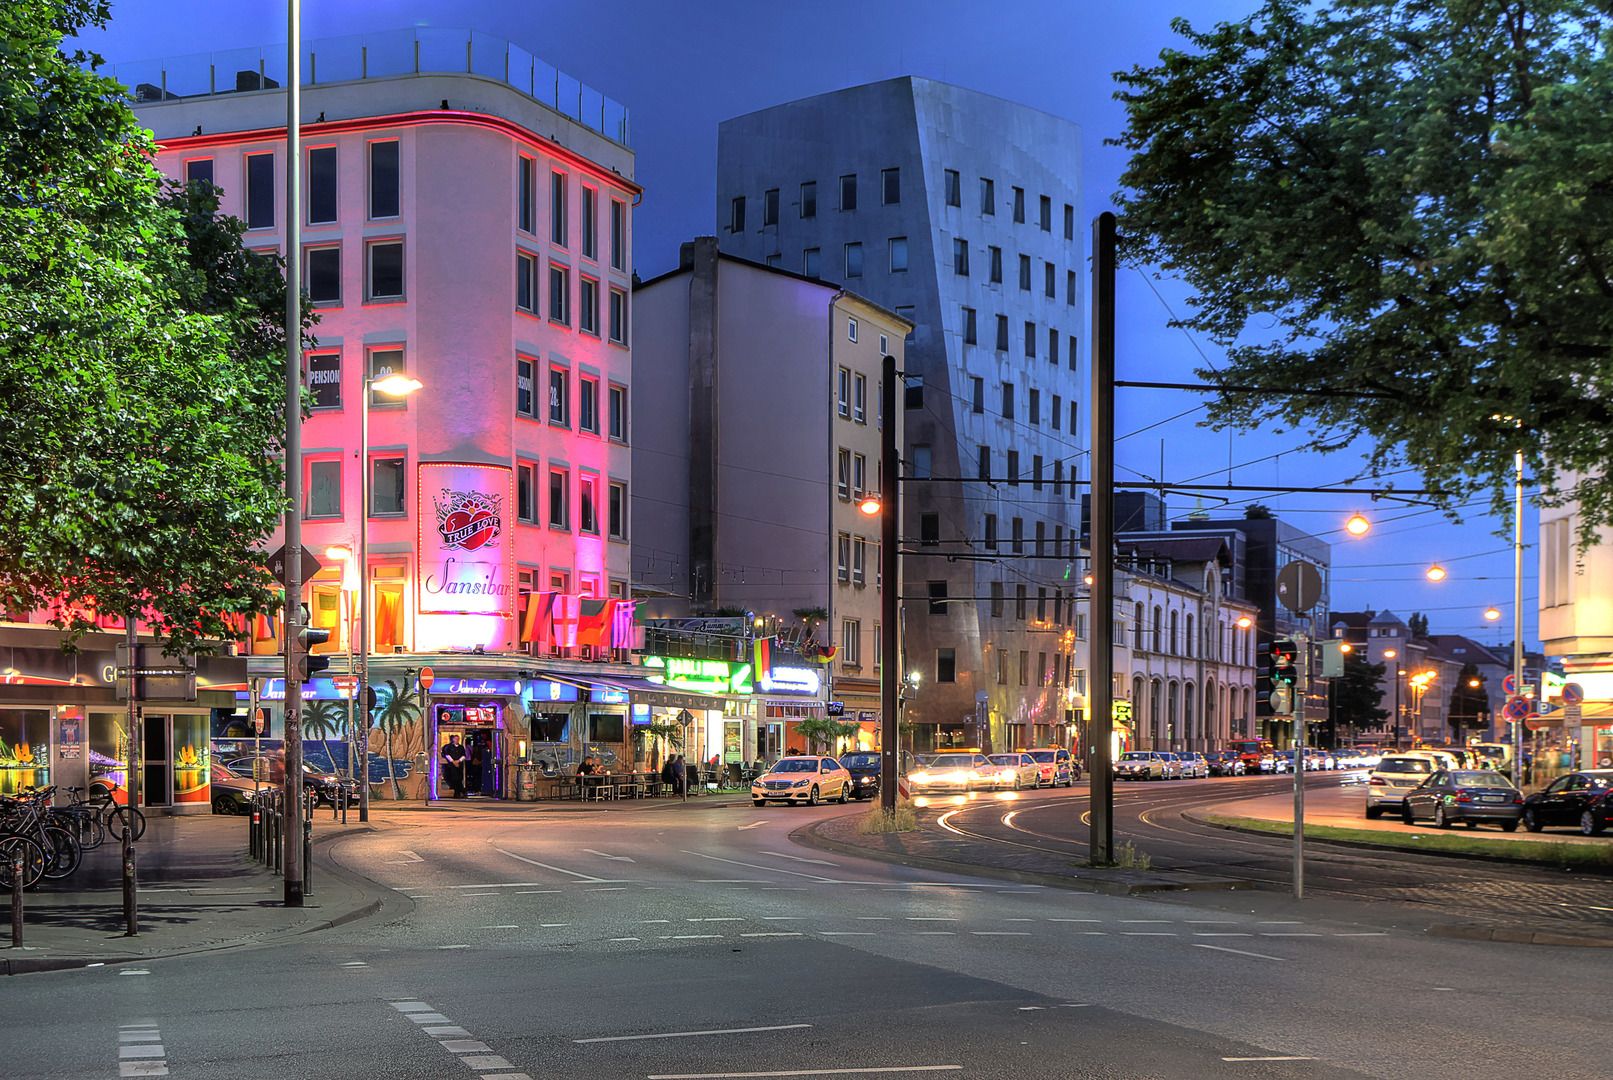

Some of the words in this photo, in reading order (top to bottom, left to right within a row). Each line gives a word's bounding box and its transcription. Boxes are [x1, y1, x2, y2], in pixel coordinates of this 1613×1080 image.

[310, 369, 340, 385] PENSION
[447, 524, 474, 543] TRUE
[476, 516, 500, 532] LOVE
[425, 557, 510, 596] Sansibar
[260, 677, 317, 700] Sanar
[449, 679, 497, 694] Sansibar
[828, 704, 842, 714] sky
[1540, 703, 1549, 713] P
